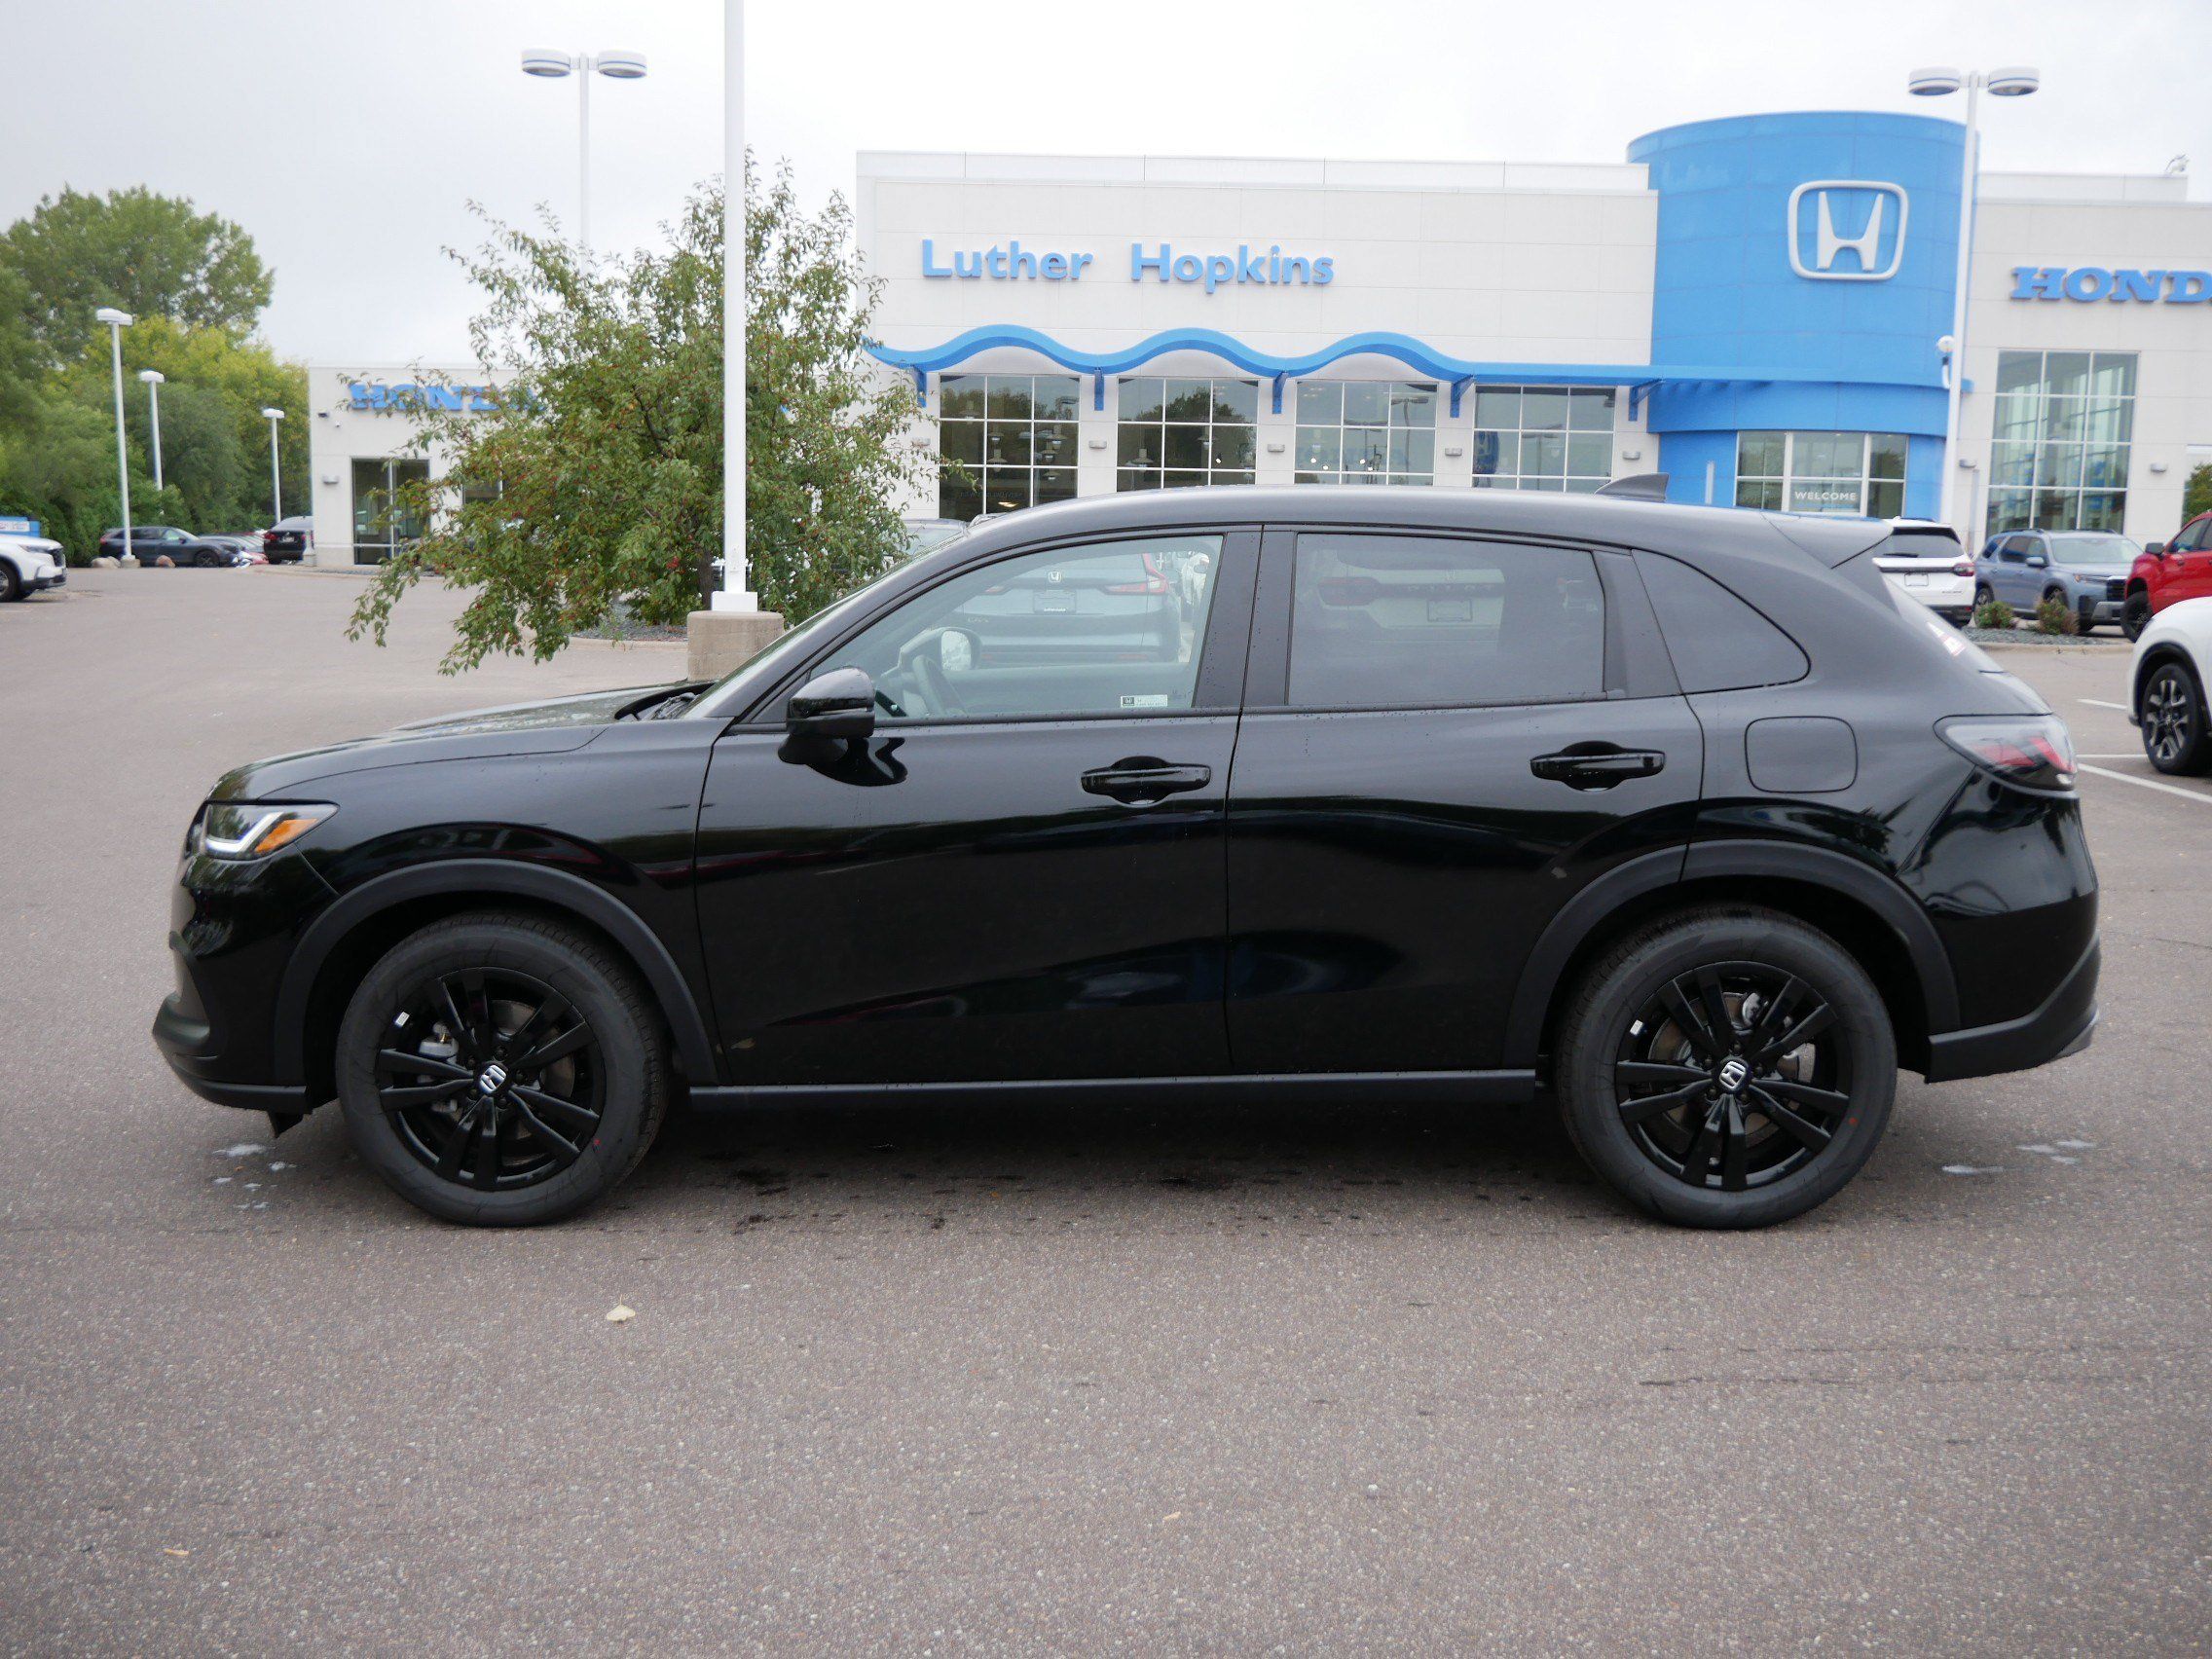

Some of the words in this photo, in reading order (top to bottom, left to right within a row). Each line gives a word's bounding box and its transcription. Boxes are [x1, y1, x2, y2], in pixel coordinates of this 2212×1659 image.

[921, 239, 1093, 281] Luther
[1130, 242, 1335, 294] Hopkins
[2009, 266, 2212, 304] HOND
[1794, 491, 1857, 501] WELCOME
